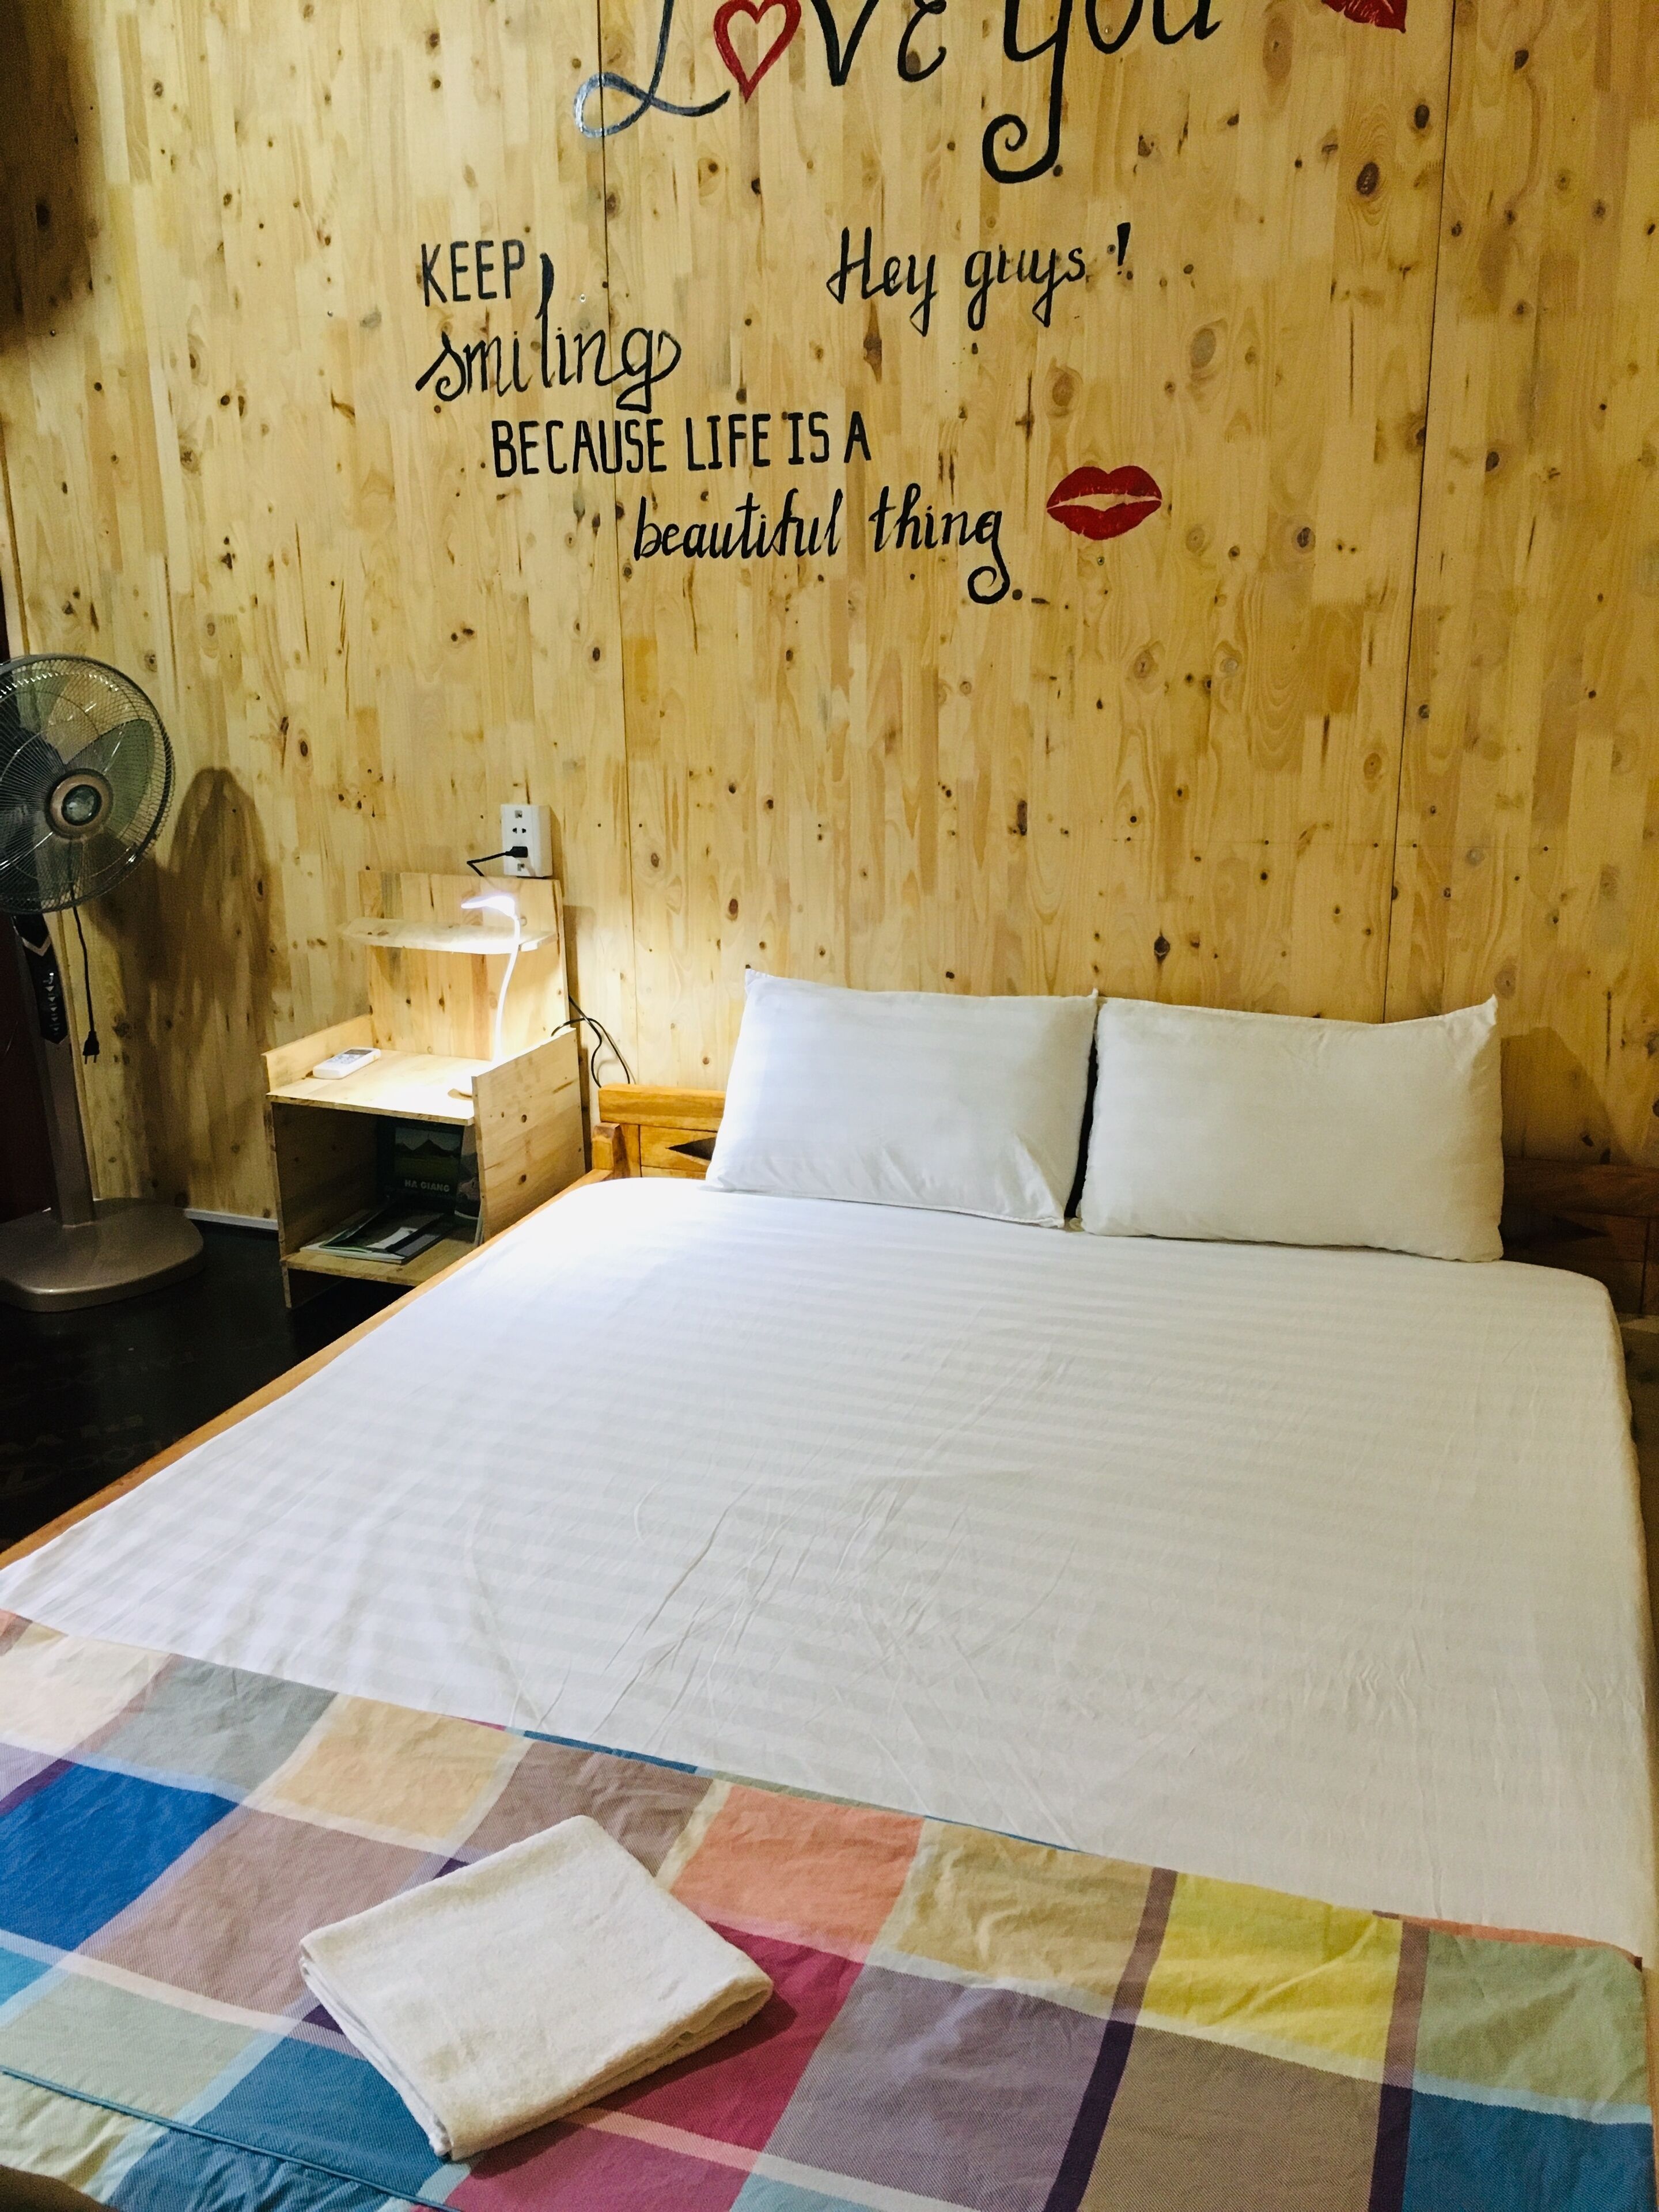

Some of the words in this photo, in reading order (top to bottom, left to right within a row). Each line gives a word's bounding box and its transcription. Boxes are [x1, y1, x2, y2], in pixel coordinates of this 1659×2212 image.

[421, 239, 525, 307] KEEP
[826, 226, 937, 337] Hey
[415, 252, 682, 414] smiling
[491, 418, 668, 478] BECAUSE
[685, 414, 771, 471] LIFE
[787, 411, 830, 464] IS
[844, 411, 872, 463] A
[634, 488, 843, 561] beautiful
[421, 1181, 450, 1192] GIANG
